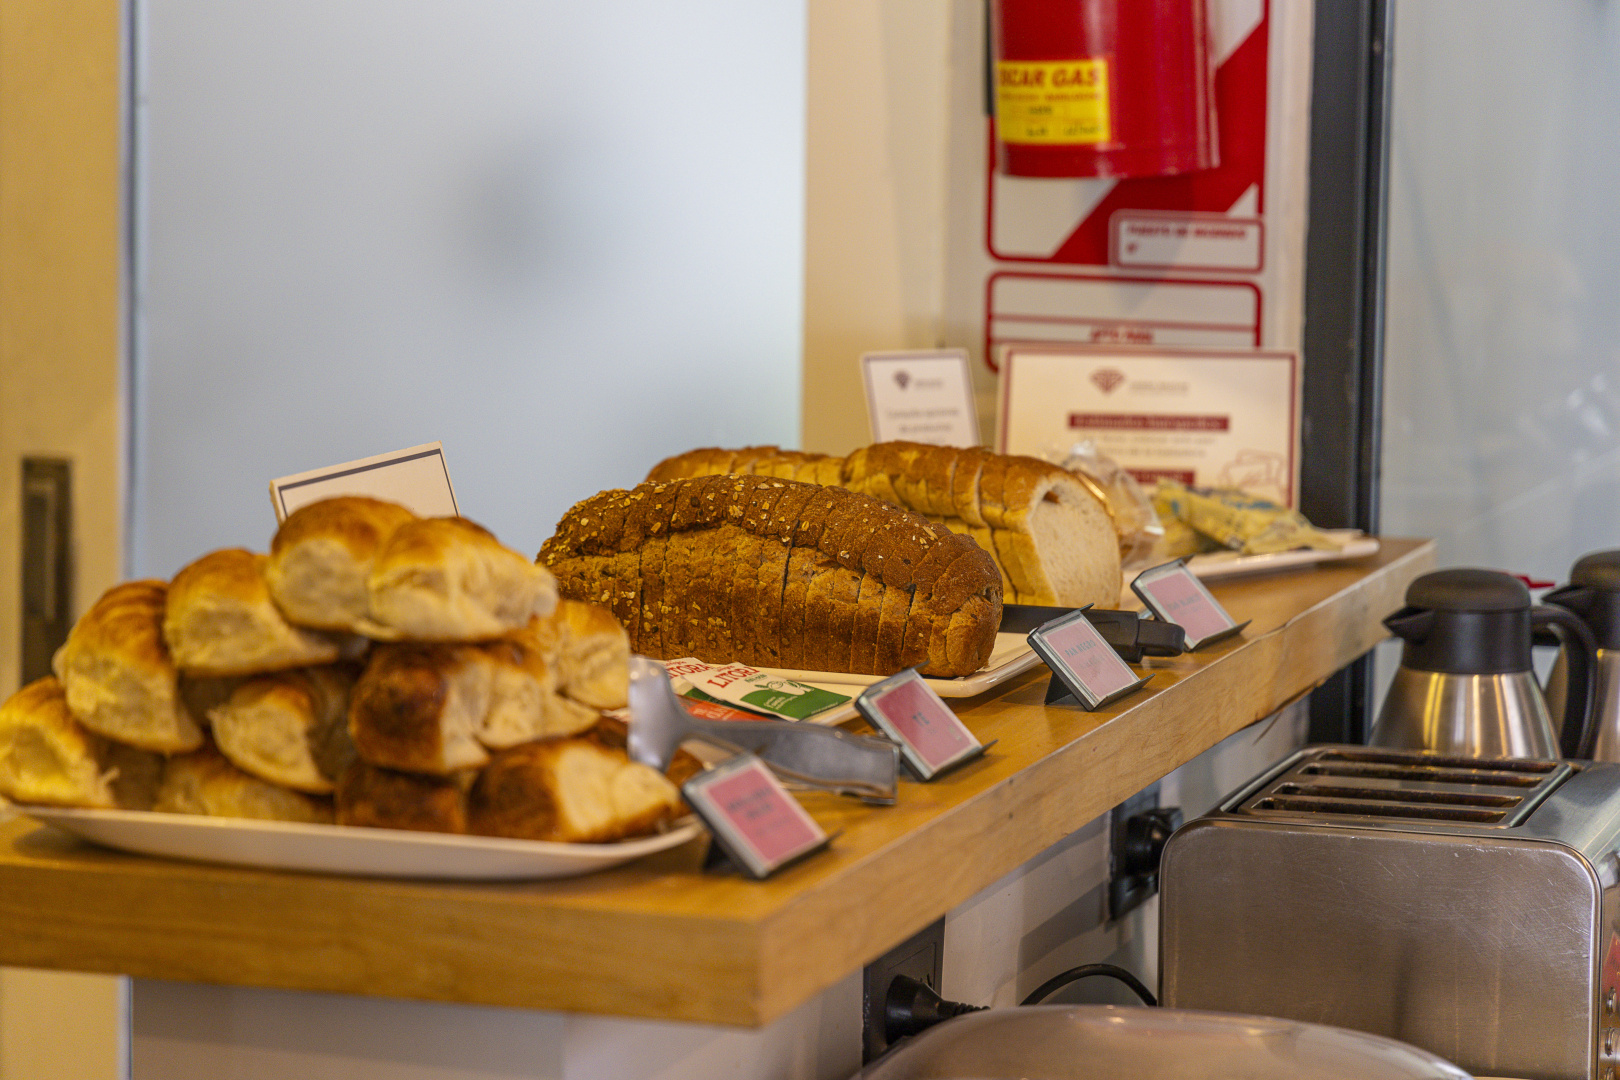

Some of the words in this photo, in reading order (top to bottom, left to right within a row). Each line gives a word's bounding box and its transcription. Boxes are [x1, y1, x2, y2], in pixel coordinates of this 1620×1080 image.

[1052, 68, 1101, 88] GAS
[1064, 646, 1078, 658] PAN
[1078, 639, 1096, 653] NEGRO
